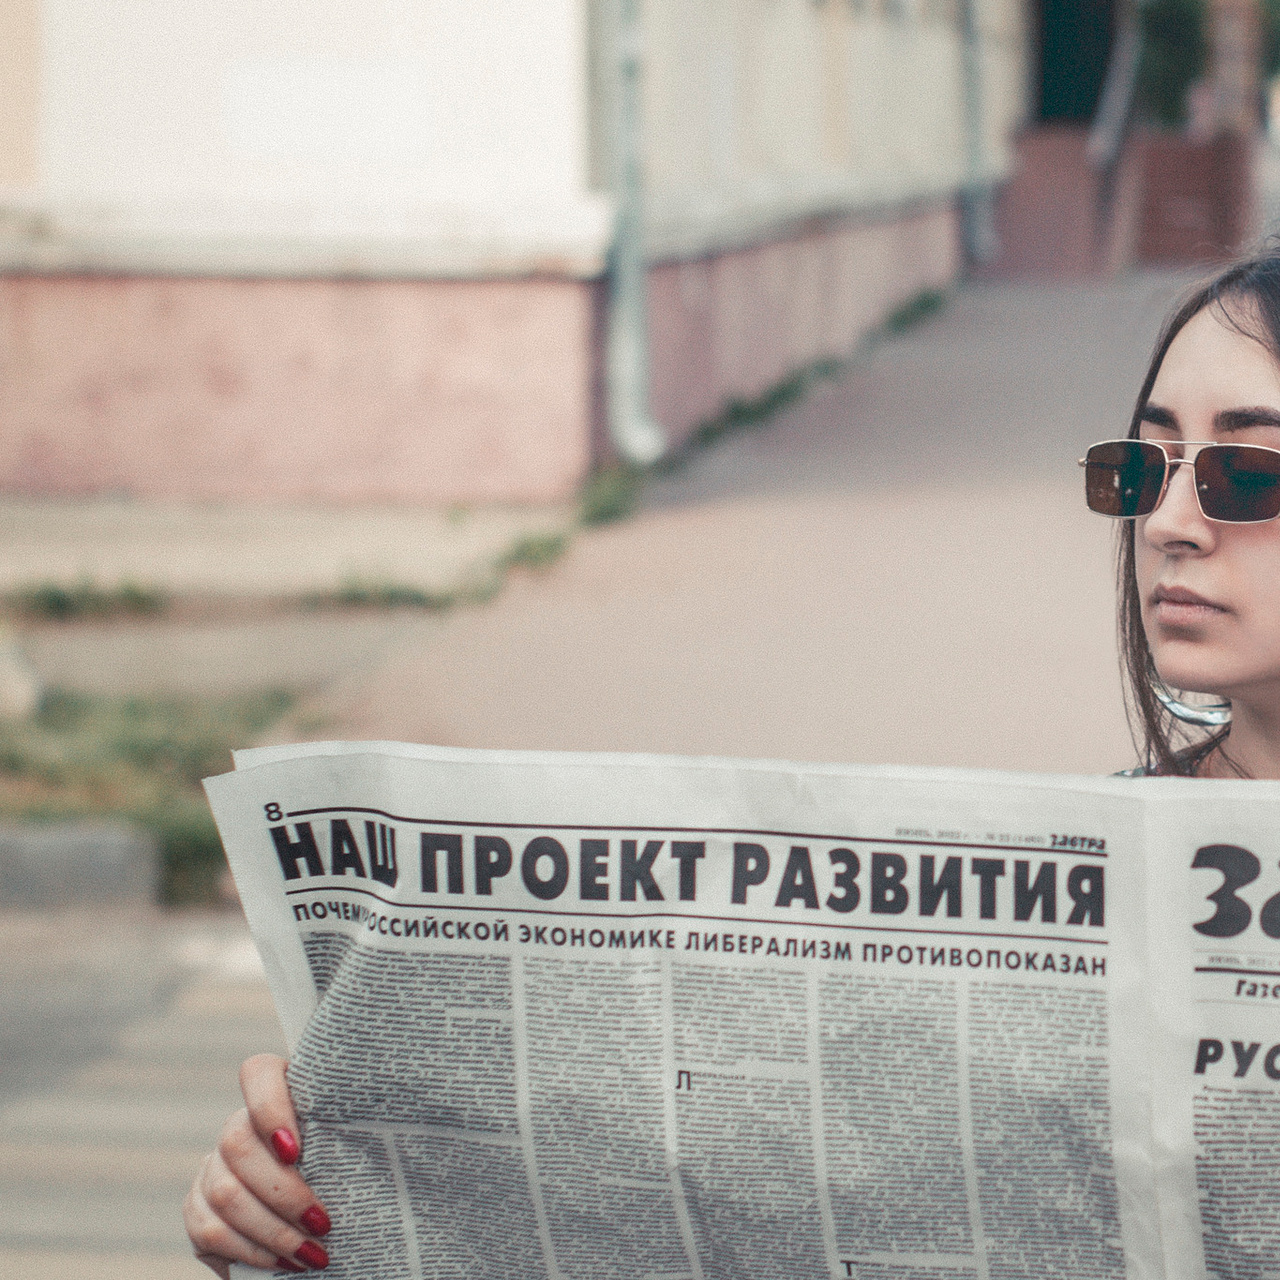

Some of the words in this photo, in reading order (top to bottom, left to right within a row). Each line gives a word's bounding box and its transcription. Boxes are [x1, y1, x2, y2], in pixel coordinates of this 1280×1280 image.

[264, 802, 283, 822] 8
[269, 819, 398, 888] НАШ
[419, 832, 706, 902] ПРОЕКТ
[730, 841, 1106, 928] РАЗВИТИЯ
[292, 901, 369, 926] ПОЧЕМ
[365, 911, 510, 943] ОССИЙСКОЙ
[518, 924, 676, 950] ЭКОНОМИКЕ
[684, 931, 853, 961] ЛИБЕРАЛИЗМ
[861, 942, 1107, 977] ПРОТИВОПОКАЗАН
